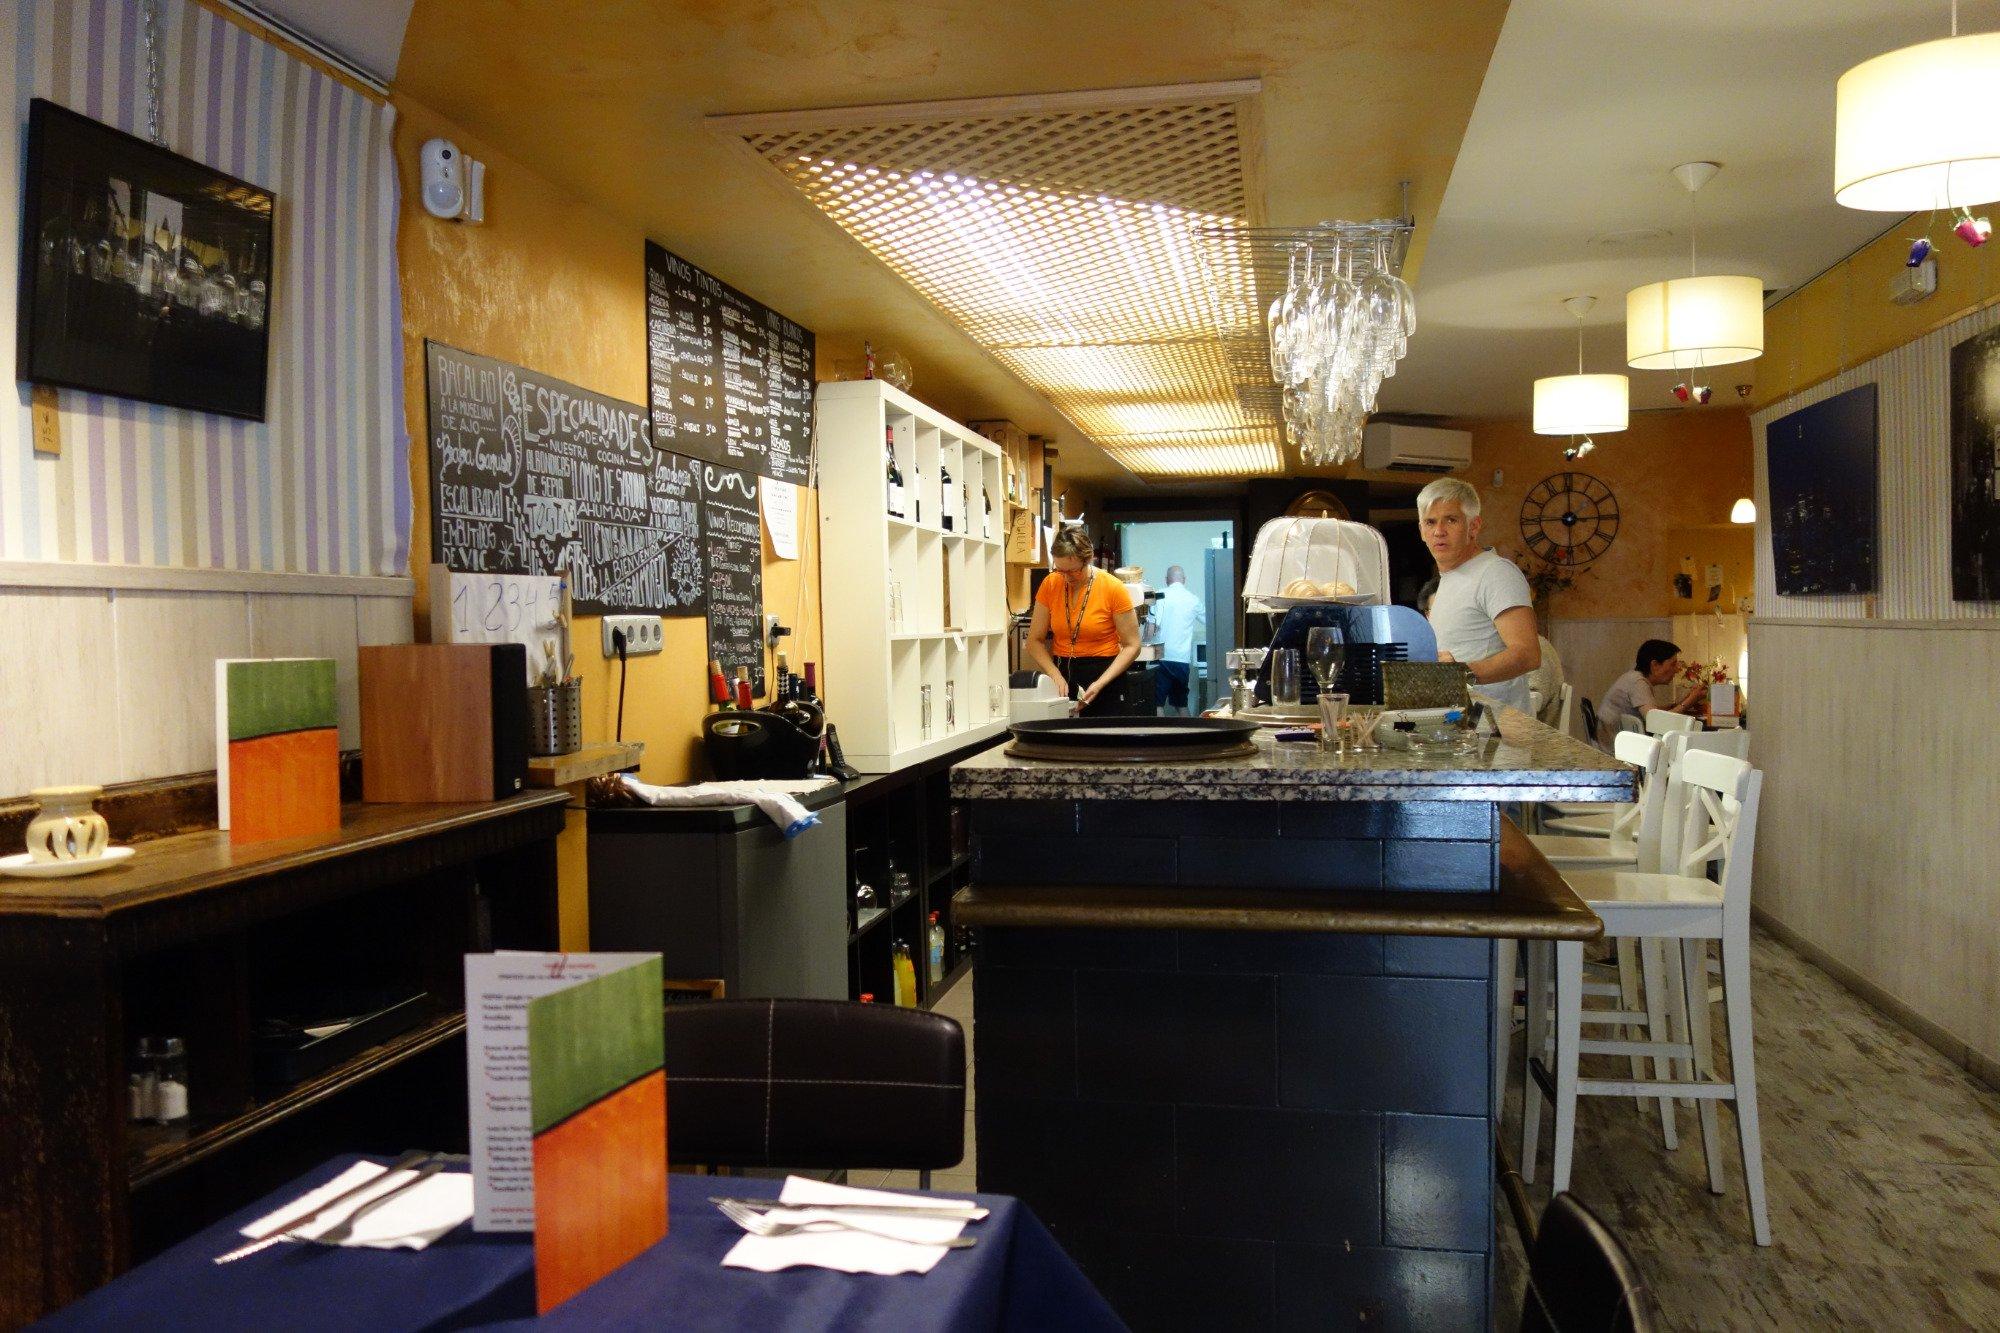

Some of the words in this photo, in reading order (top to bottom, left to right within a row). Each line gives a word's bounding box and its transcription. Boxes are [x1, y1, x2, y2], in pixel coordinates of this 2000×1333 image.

[438, 355, 497, 404] BACALAO
[442, 414, 457, 431] DE
[521, 381, 654, 467] ESPECIALIDADES
[585, 429, 599, 446] DE
[549, 439, 589, 461] NUESTRA
[597, 450, 625, 465] COCINA
[526, 474, 537, 495] DE
[603, 466, 615, 505] DE
[525, 499, 578, 541] TOSTAS
[576, 502, 641, 523] AHUMADA
[443, 547, 457, 568] DE
